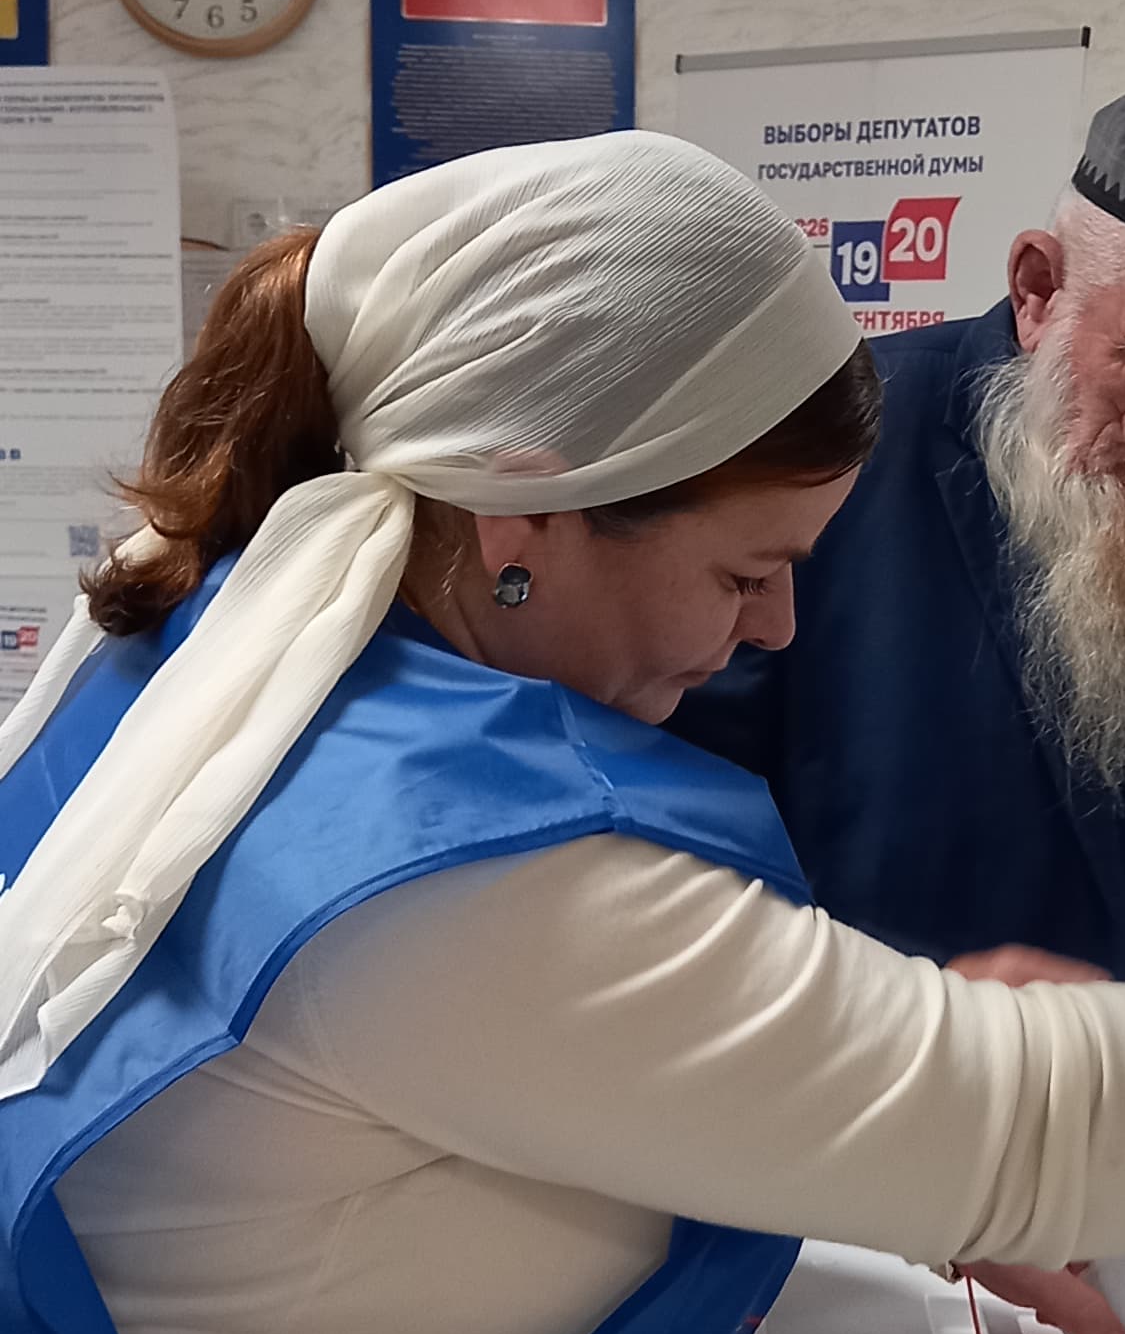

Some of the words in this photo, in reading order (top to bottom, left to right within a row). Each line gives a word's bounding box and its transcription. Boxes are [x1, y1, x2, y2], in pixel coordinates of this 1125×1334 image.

[206, 4, 225, 28] 6
[763, 122, 852, 145] ВЫБОРЫ
[856, 116, 981, 144] ДЕПУТАТОВ
[757, 154, 925, 182] ГОСУДАРСТВЕННОЙ
[928, 155, 984, 177] ДУМЫ
[889, 217, 943, 263] 20
[836, 241, 878, 286] 19
